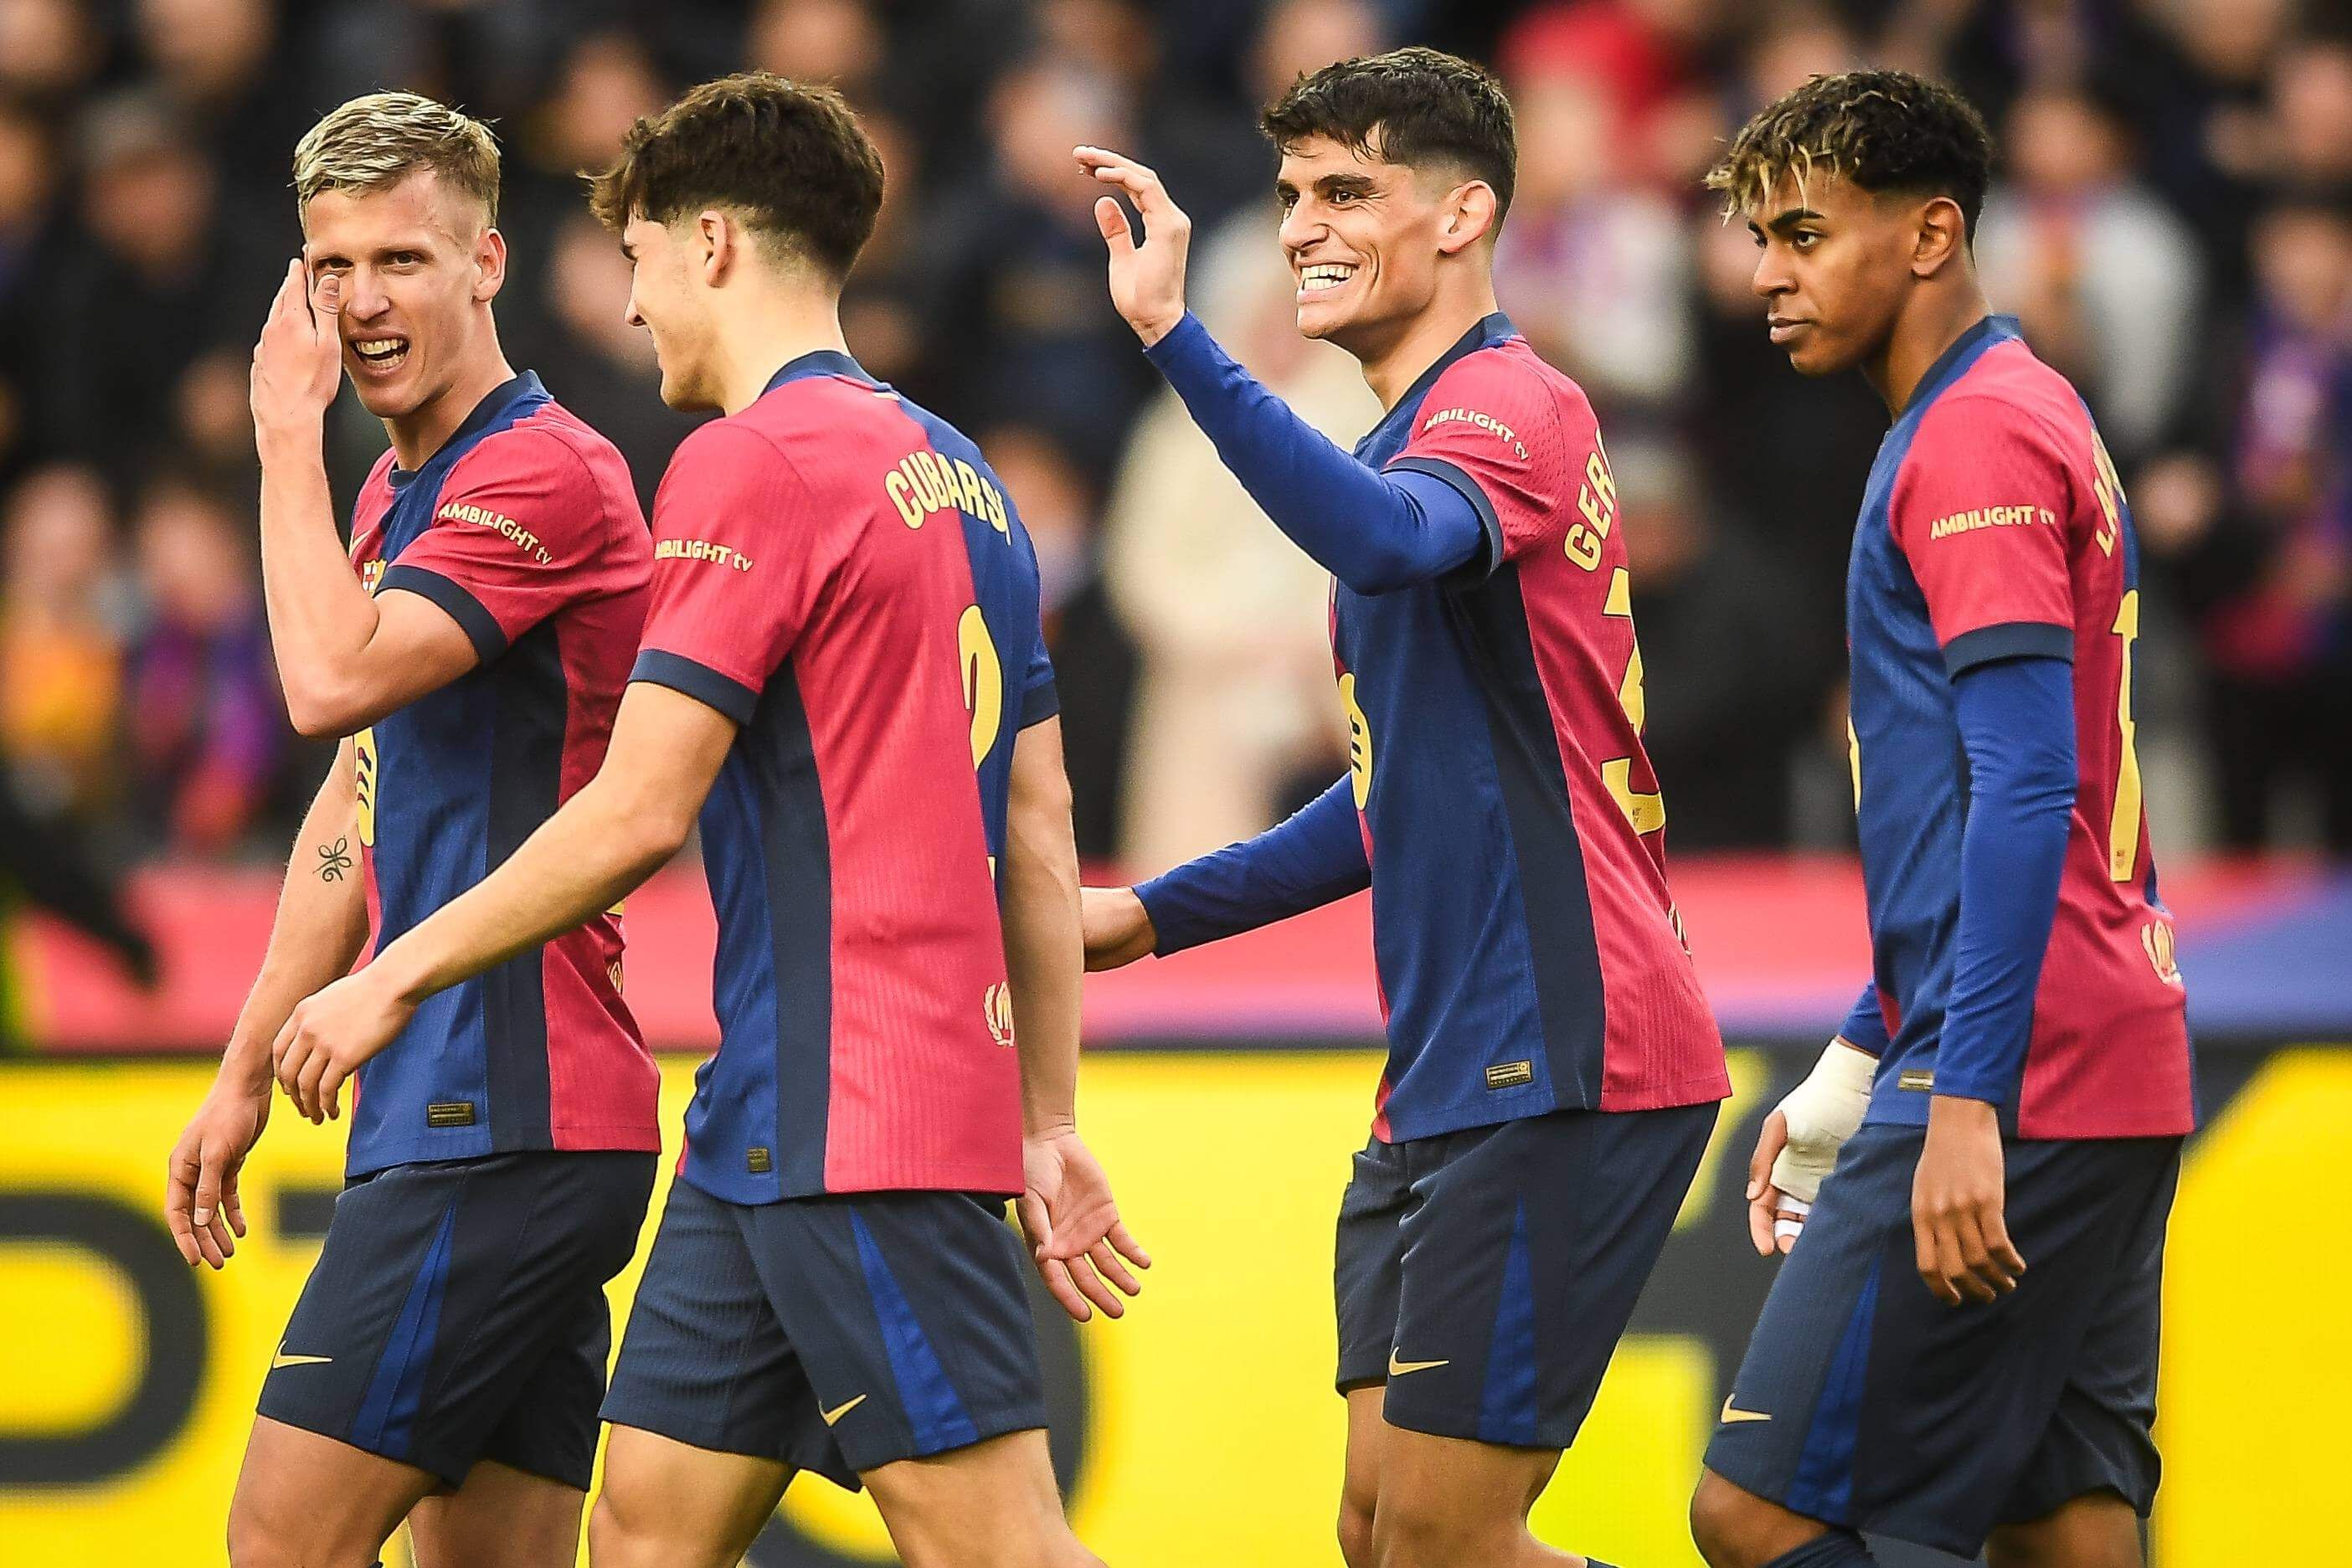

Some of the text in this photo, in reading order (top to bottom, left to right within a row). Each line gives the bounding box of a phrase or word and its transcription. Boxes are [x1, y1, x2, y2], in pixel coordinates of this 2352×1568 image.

[1423, 407, 1516, 443] MBILIGHT
[1563, 427, 1617, 573] GER
[438, 502, 553, 565] AMBILIGHT tv
[1930, 504, 2035, 541] AMBILIGHT
[733, 553, 754, 573] tv
